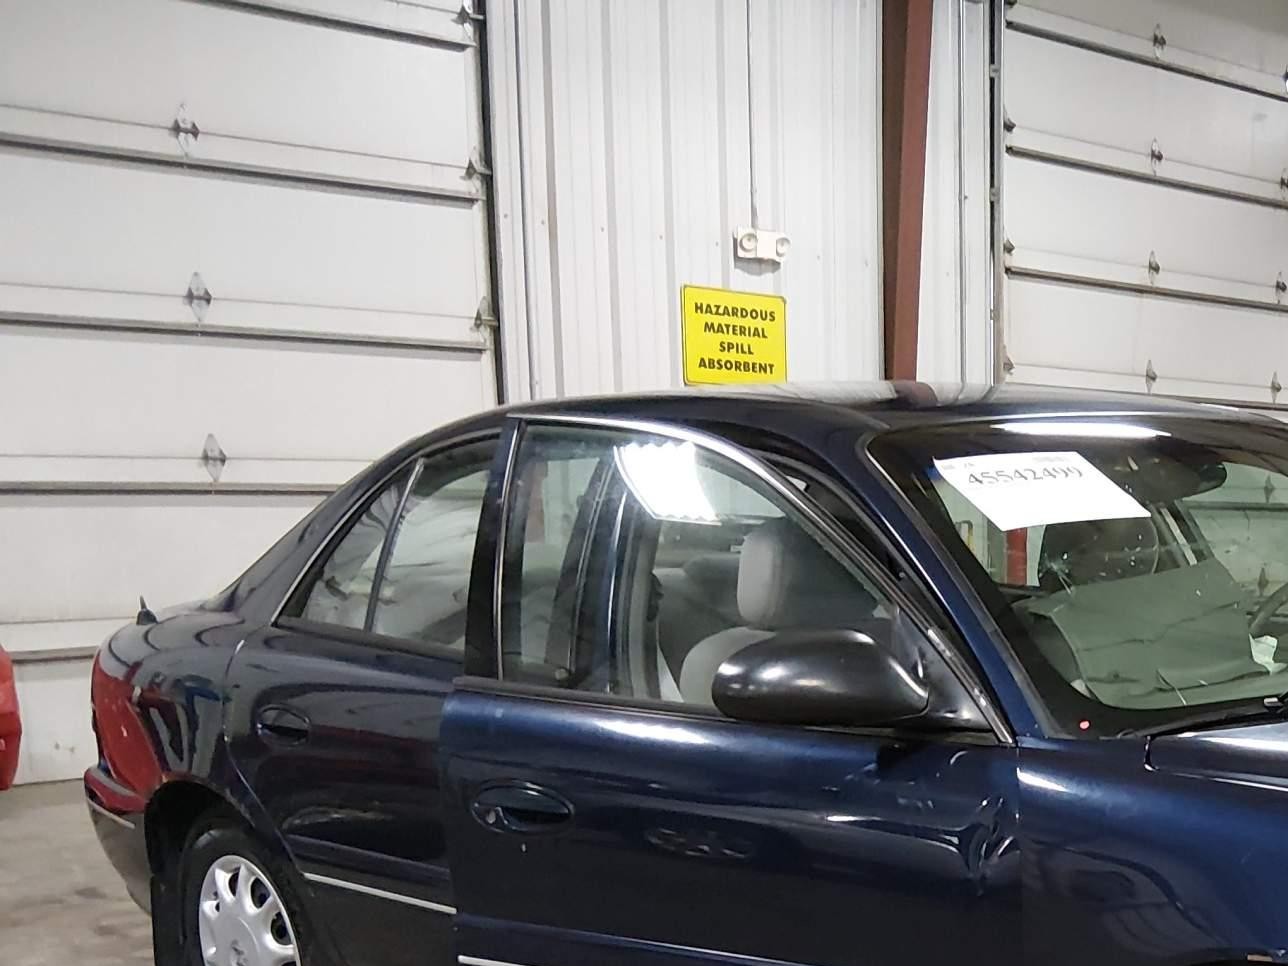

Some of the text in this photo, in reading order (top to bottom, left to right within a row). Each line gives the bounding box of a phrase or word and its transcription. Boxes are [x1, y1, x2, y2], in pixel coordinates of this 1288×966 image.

[694, 302, 776, 322] HAZARDOUS
[703, 322, 768, 339] MATERIAL
[719, 341, 754, 355] SPILL
[698, 357, 775, 375] ABSORBENT
[968, 467, 1083, 484] 45542499
